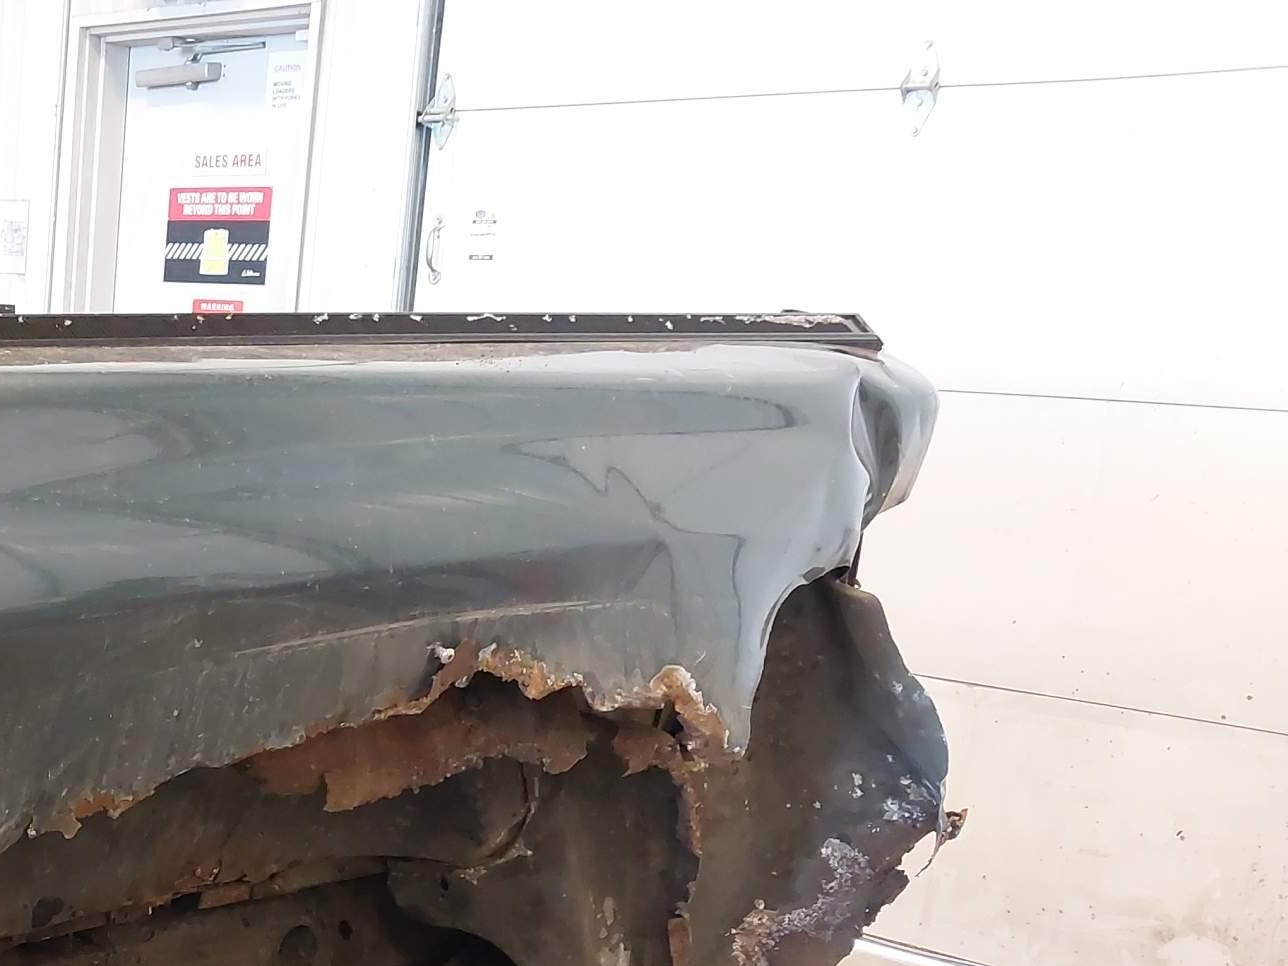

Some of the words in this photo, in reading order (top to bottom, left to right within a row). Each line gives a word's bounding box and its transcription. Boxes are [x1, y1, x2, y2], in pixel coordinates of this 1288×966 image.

[194, 155, 228, 168] SALES
[232, 154, 261, 168] AREA
[177, 192, 200, 204] VESTS
[201, 192, 216, 204] ARE
[217, 192, 227, 204] TO
[228, 192, 238, 204] BE
[183, 204, 213, 216] BEYOND
[214, 204, 231, 216] THIS
[231, 204, 256, 216] POINT
